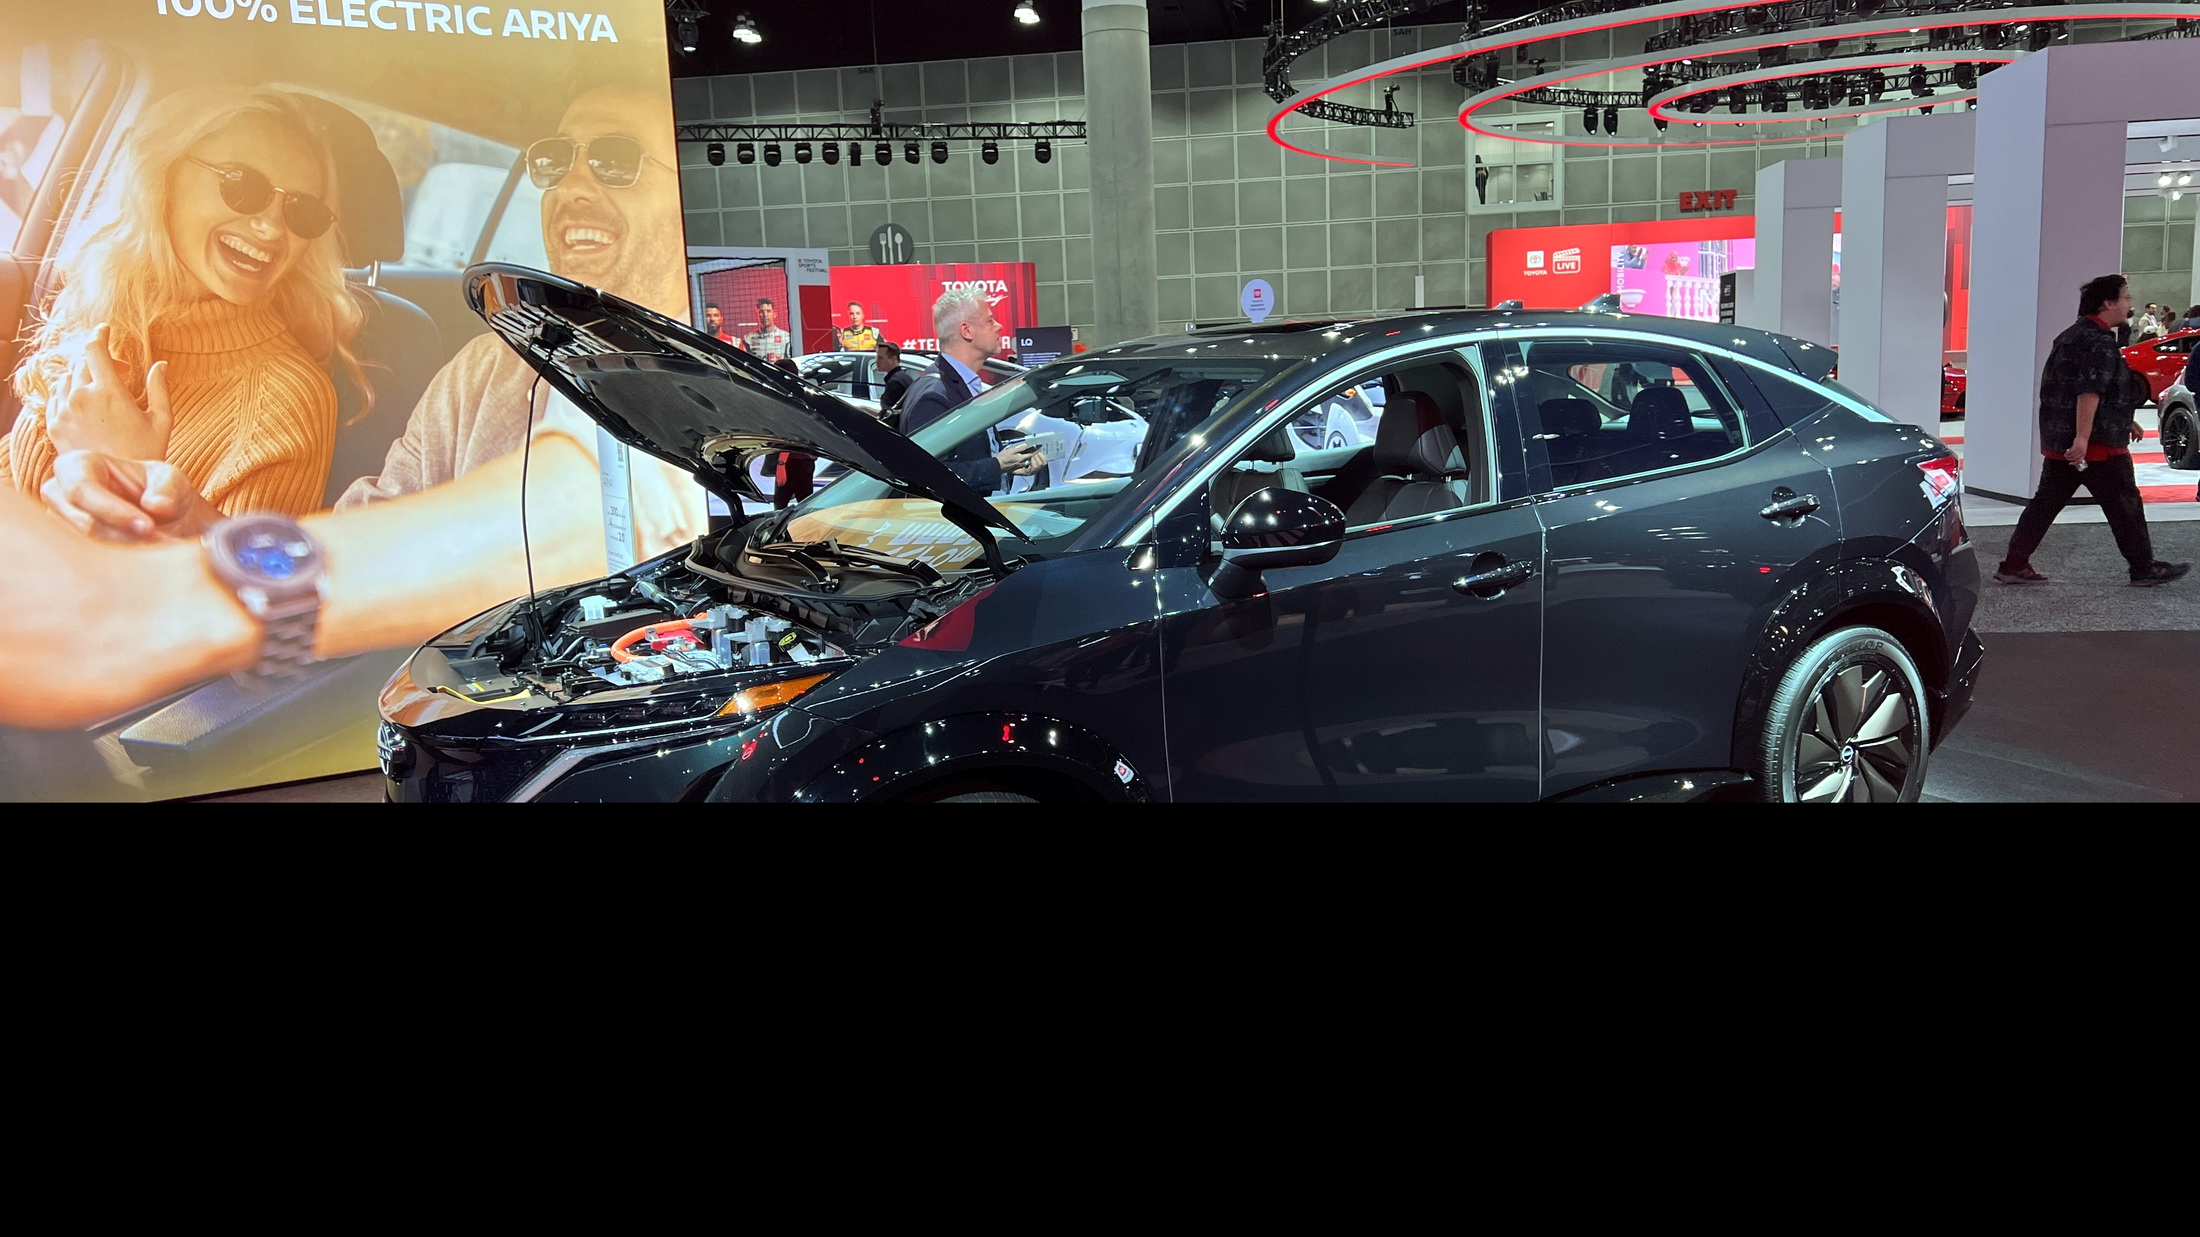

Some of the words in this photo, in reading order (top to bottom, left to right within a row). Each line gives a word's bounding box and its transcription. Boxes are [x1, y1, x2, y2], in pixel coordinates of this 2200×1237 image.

[289, 0, 493, 36] ELECTRIC
[501, 8, 619, 43] ARIYA
[1679, 189, 1737, 212] EXIT
[1556, 262, 1577, 270] LIVE
[1616, 252, 1625, 293] MOBILITY
[941, 280, 1009, 293] TOYOTA
[1020, 338, 1034, 347] LQ
